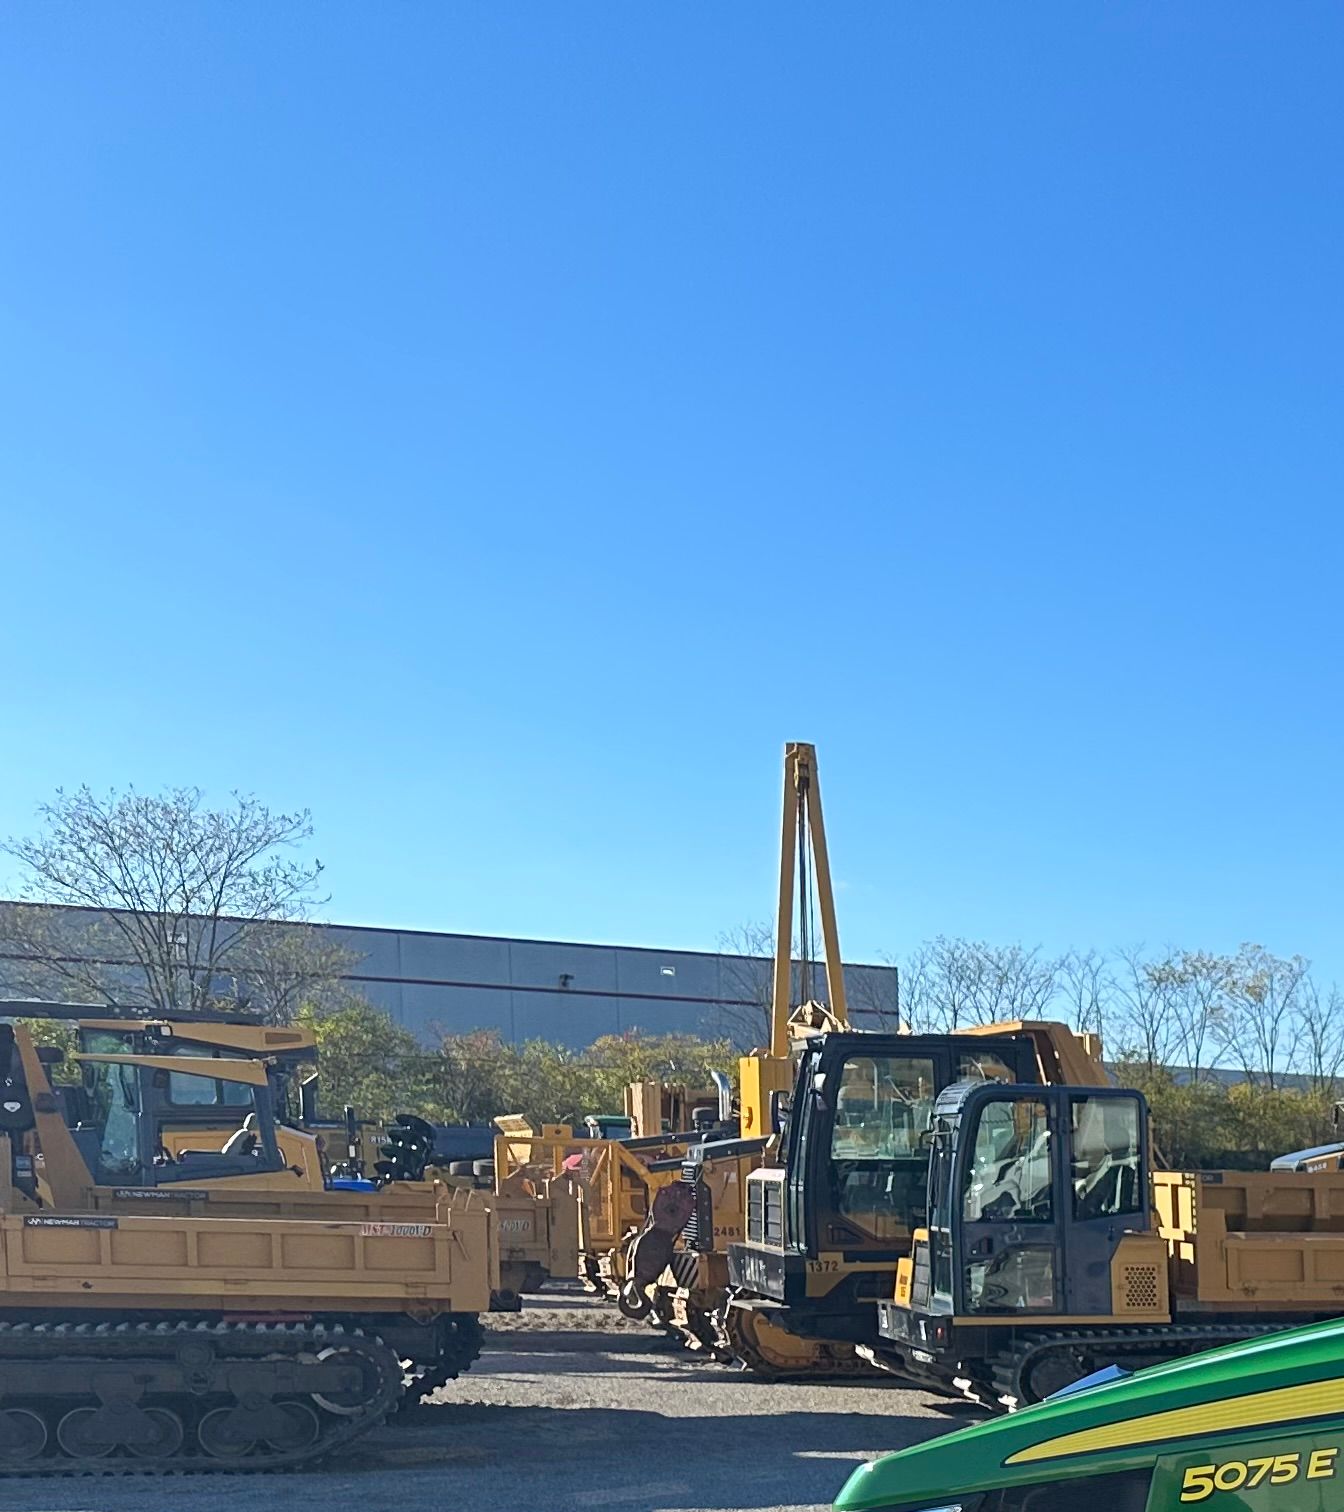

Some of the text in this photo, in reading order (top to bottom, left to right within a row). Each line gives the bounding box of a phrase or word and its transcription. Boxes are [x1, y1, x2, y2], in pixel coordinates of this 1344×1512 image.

[132, 1190, 207, 1200] NEWMAN TRACTOR
[43, 1218, 116, 1228] NEWMAN TRACTOR
[714, 1227, 741, 1237] 2481
[809, 1261, 839, 1272] 1372
[1180, 1447, 1339, 1503] 5075 E
